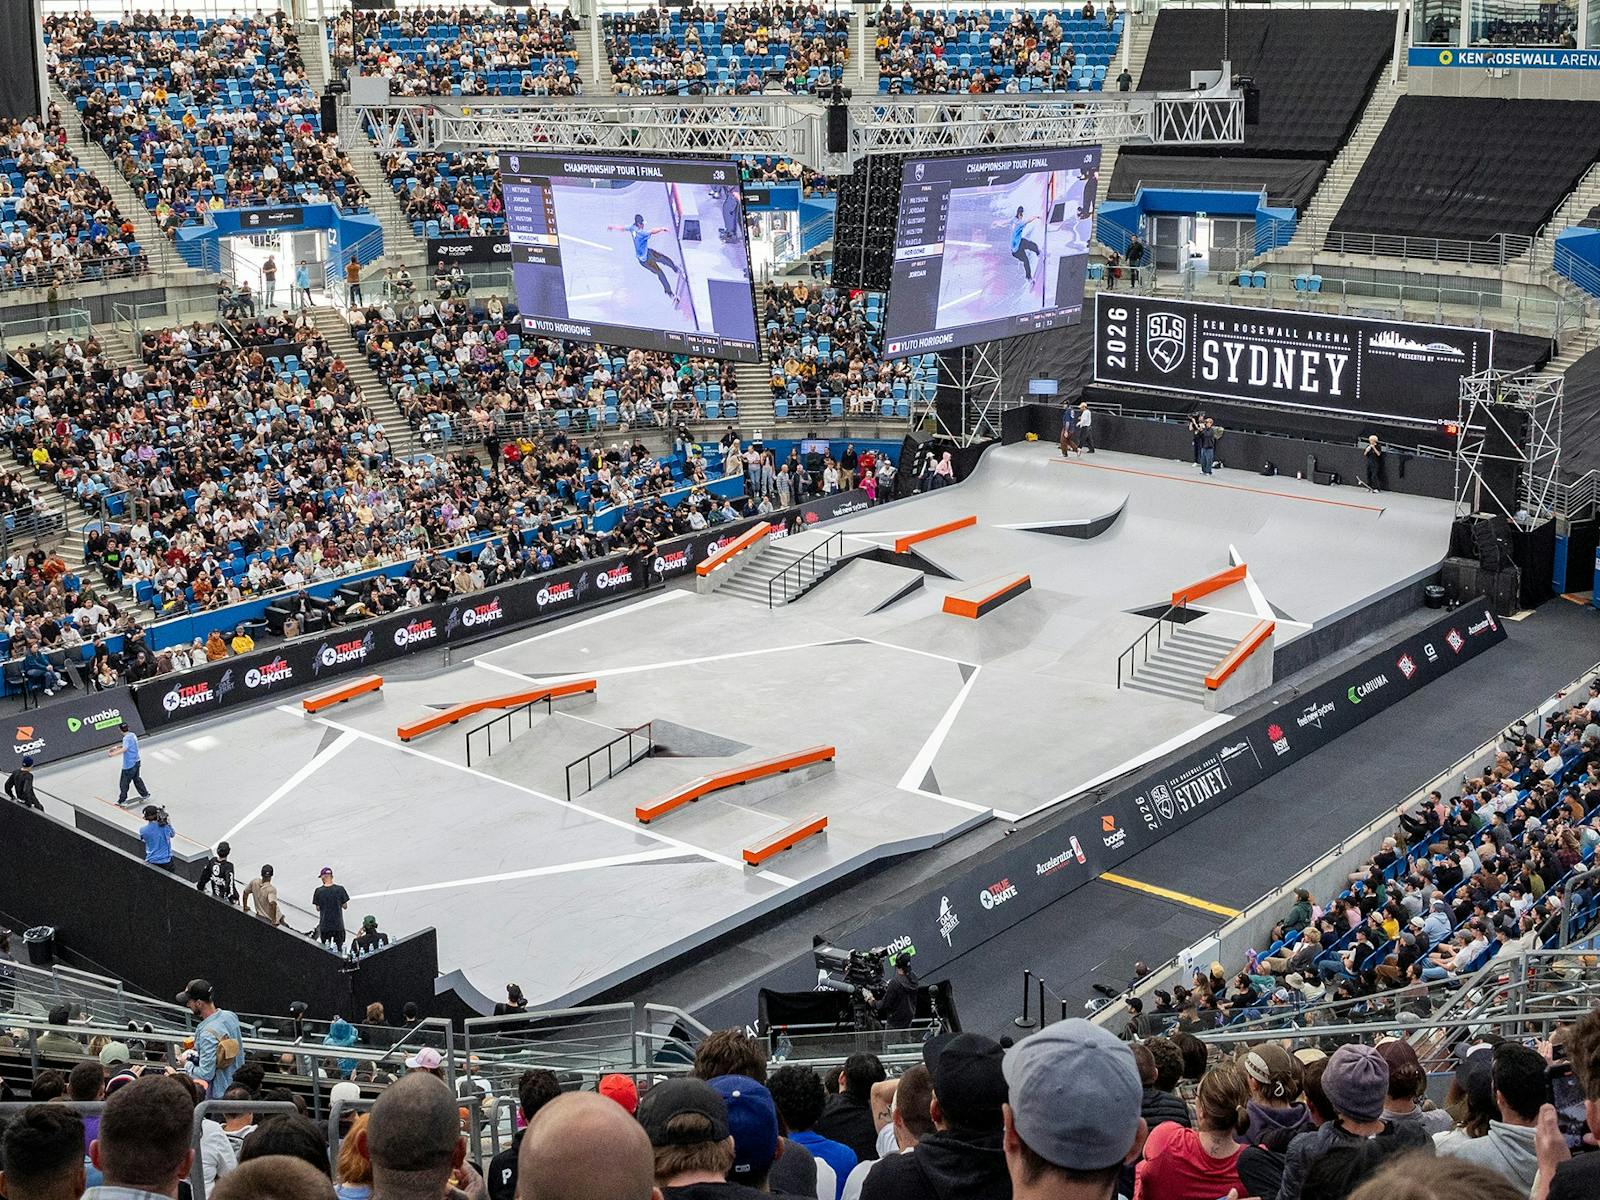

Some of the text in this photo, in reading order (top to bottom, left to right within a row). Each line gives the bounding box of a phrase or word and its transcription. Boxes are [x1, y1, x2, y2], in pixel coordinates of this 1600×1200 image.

[1459, 52, 1484, 64] KEN
[1487, 53, 1557, 65] ROSEWALL
[564, 162, 663, 177] CHAMPIONSHIP TOUR FINAL
[966, 157, 1048, 173] CHAMPIONSHIP TOUR FINAL
[448, 245, 473, 253] boost
[908, 270, 927, 279] JORDAN
[536, 320, 591, 336] YUTO HORIGOME
[1150, 316, 1183, 340] SLS
[1203, 320, 1349, 344] KEN ROSEWALL ARENA
[900, 334, 953, 351] YUTO HORIGOME
[1107, 307, 1128, 369] 2026
[1398, 352, 1427, 362] PRESENTED
[1202, 339, 1349, 395] SYDNEY
[664, 551, 684, 562] TRUE
[664, 558, 688, 571] SKATE
[607, 566, 629, 578] TRUE
[608, 572, 632, 587] SKATE
[548, 581, 570, 594] TRUE
[548, 588, 574, 604] SKATE
[474, 602, 499, 615] TRUE
[475, 608, 503, 625] SKATE
[407, 620, 433, 635] TRUE
[408, 627, 437, 643] SKATE
[335, 640, 362, 654] TRUE
[336, 646, 367, 664] SKATE
[259, 659, 287, 675] TRUE
[260, 667, 292, 685] SKATE
[179, 682, 209, 698] TRUE
[1357, 673, 1389, 698] CARIUMA
[180, 689, 214, 708] SKATE
[83, 708, 120, 725] rumble
[13, 738, 46, 754] boost
[23, 748, 41, 757] mobile
[1272, 736, 1289, 753] NSW
[1153, 786, 1169, 803] SLS
[1175, 767, 1227, 812] SYDNEY
[1135, 796, 1159, 831] 2026
[1103, 828, 1127, 847] boost
[1036, 848, 1075, 875] Accelerator
[988, 878, 1011, 896] TRUE
[993, 885, 1018, 906] SKATE
[940, 910, 953, 925] OAK
[940, 914, 959, 936] BERRY
[887, 935, 912, 955] mble
